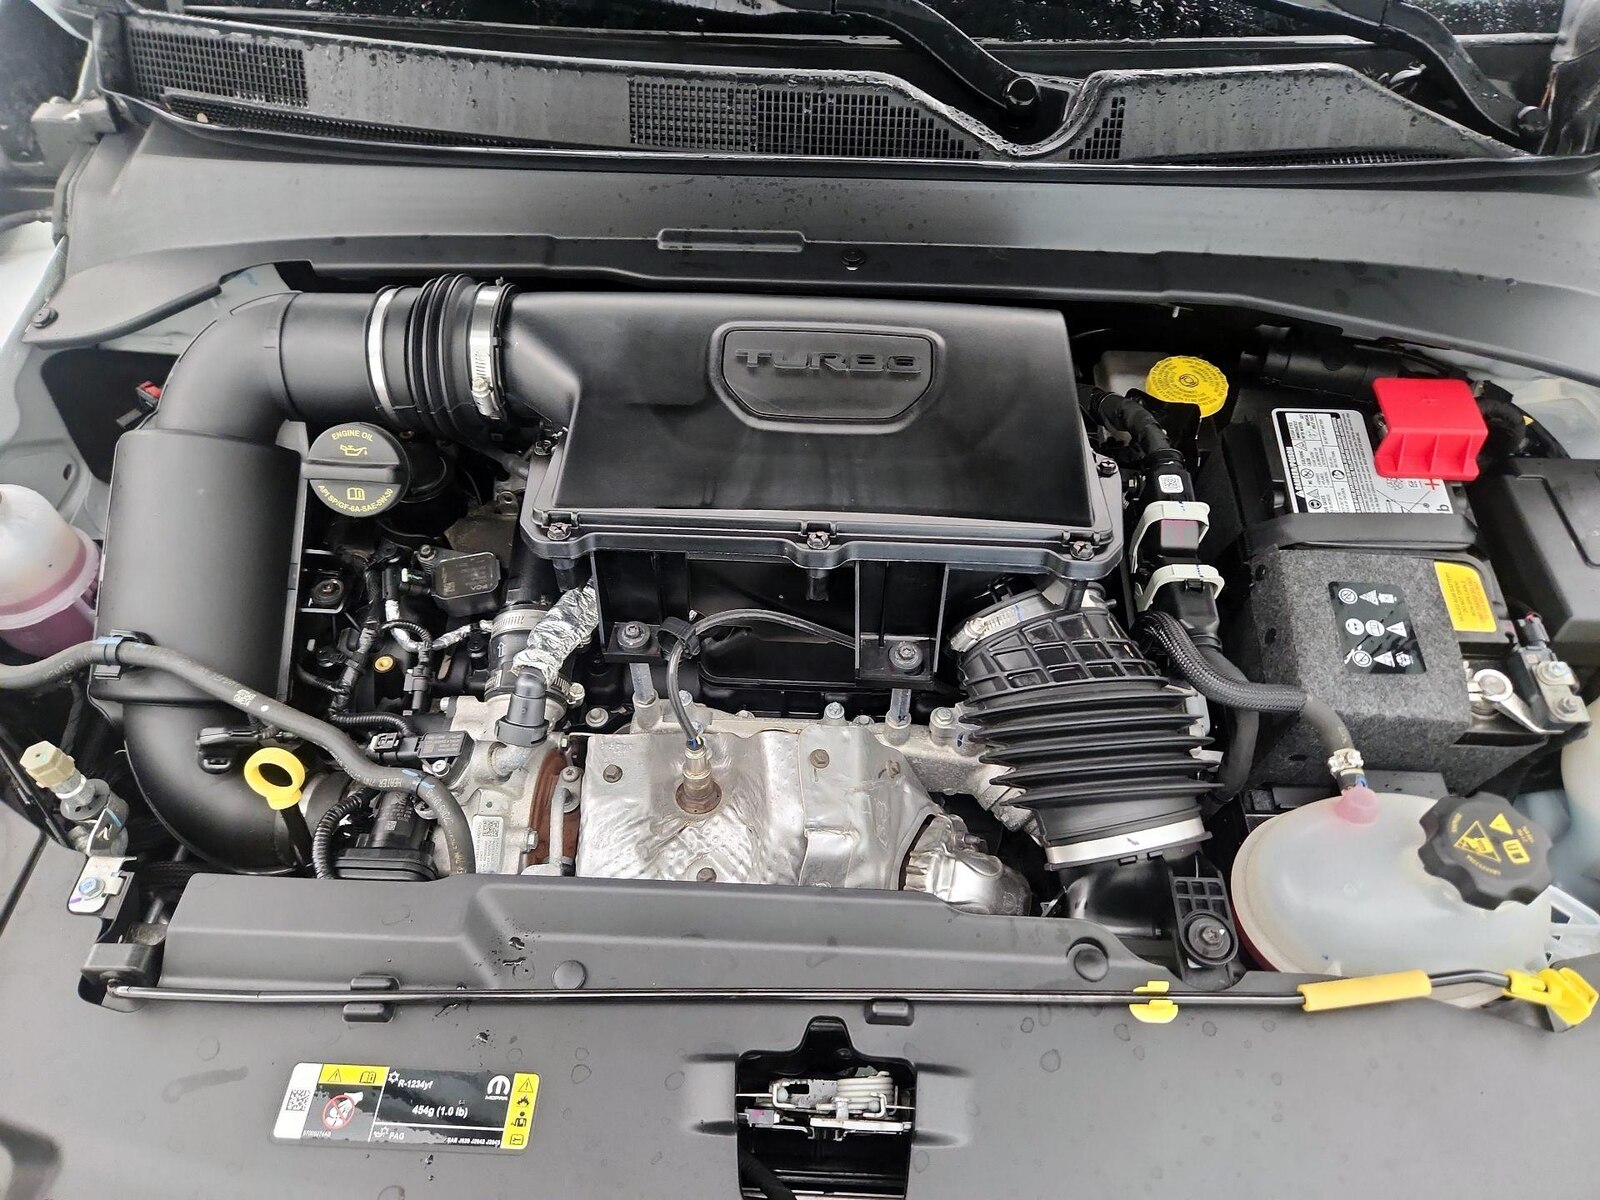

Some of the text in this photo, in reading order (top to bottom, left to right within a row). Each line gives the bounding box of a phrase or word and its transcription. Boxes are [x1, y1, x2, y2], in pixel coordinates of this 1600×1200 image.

[735, 349, 922, 374] TURBO
[331, 429, 374, 442] ENGINE OIL
[317, 485, 328, 497] API
[398, 1079, 433, 1091] R-1234yf
[412, 1104, 468, 1119] 454g (1.0 lb)
